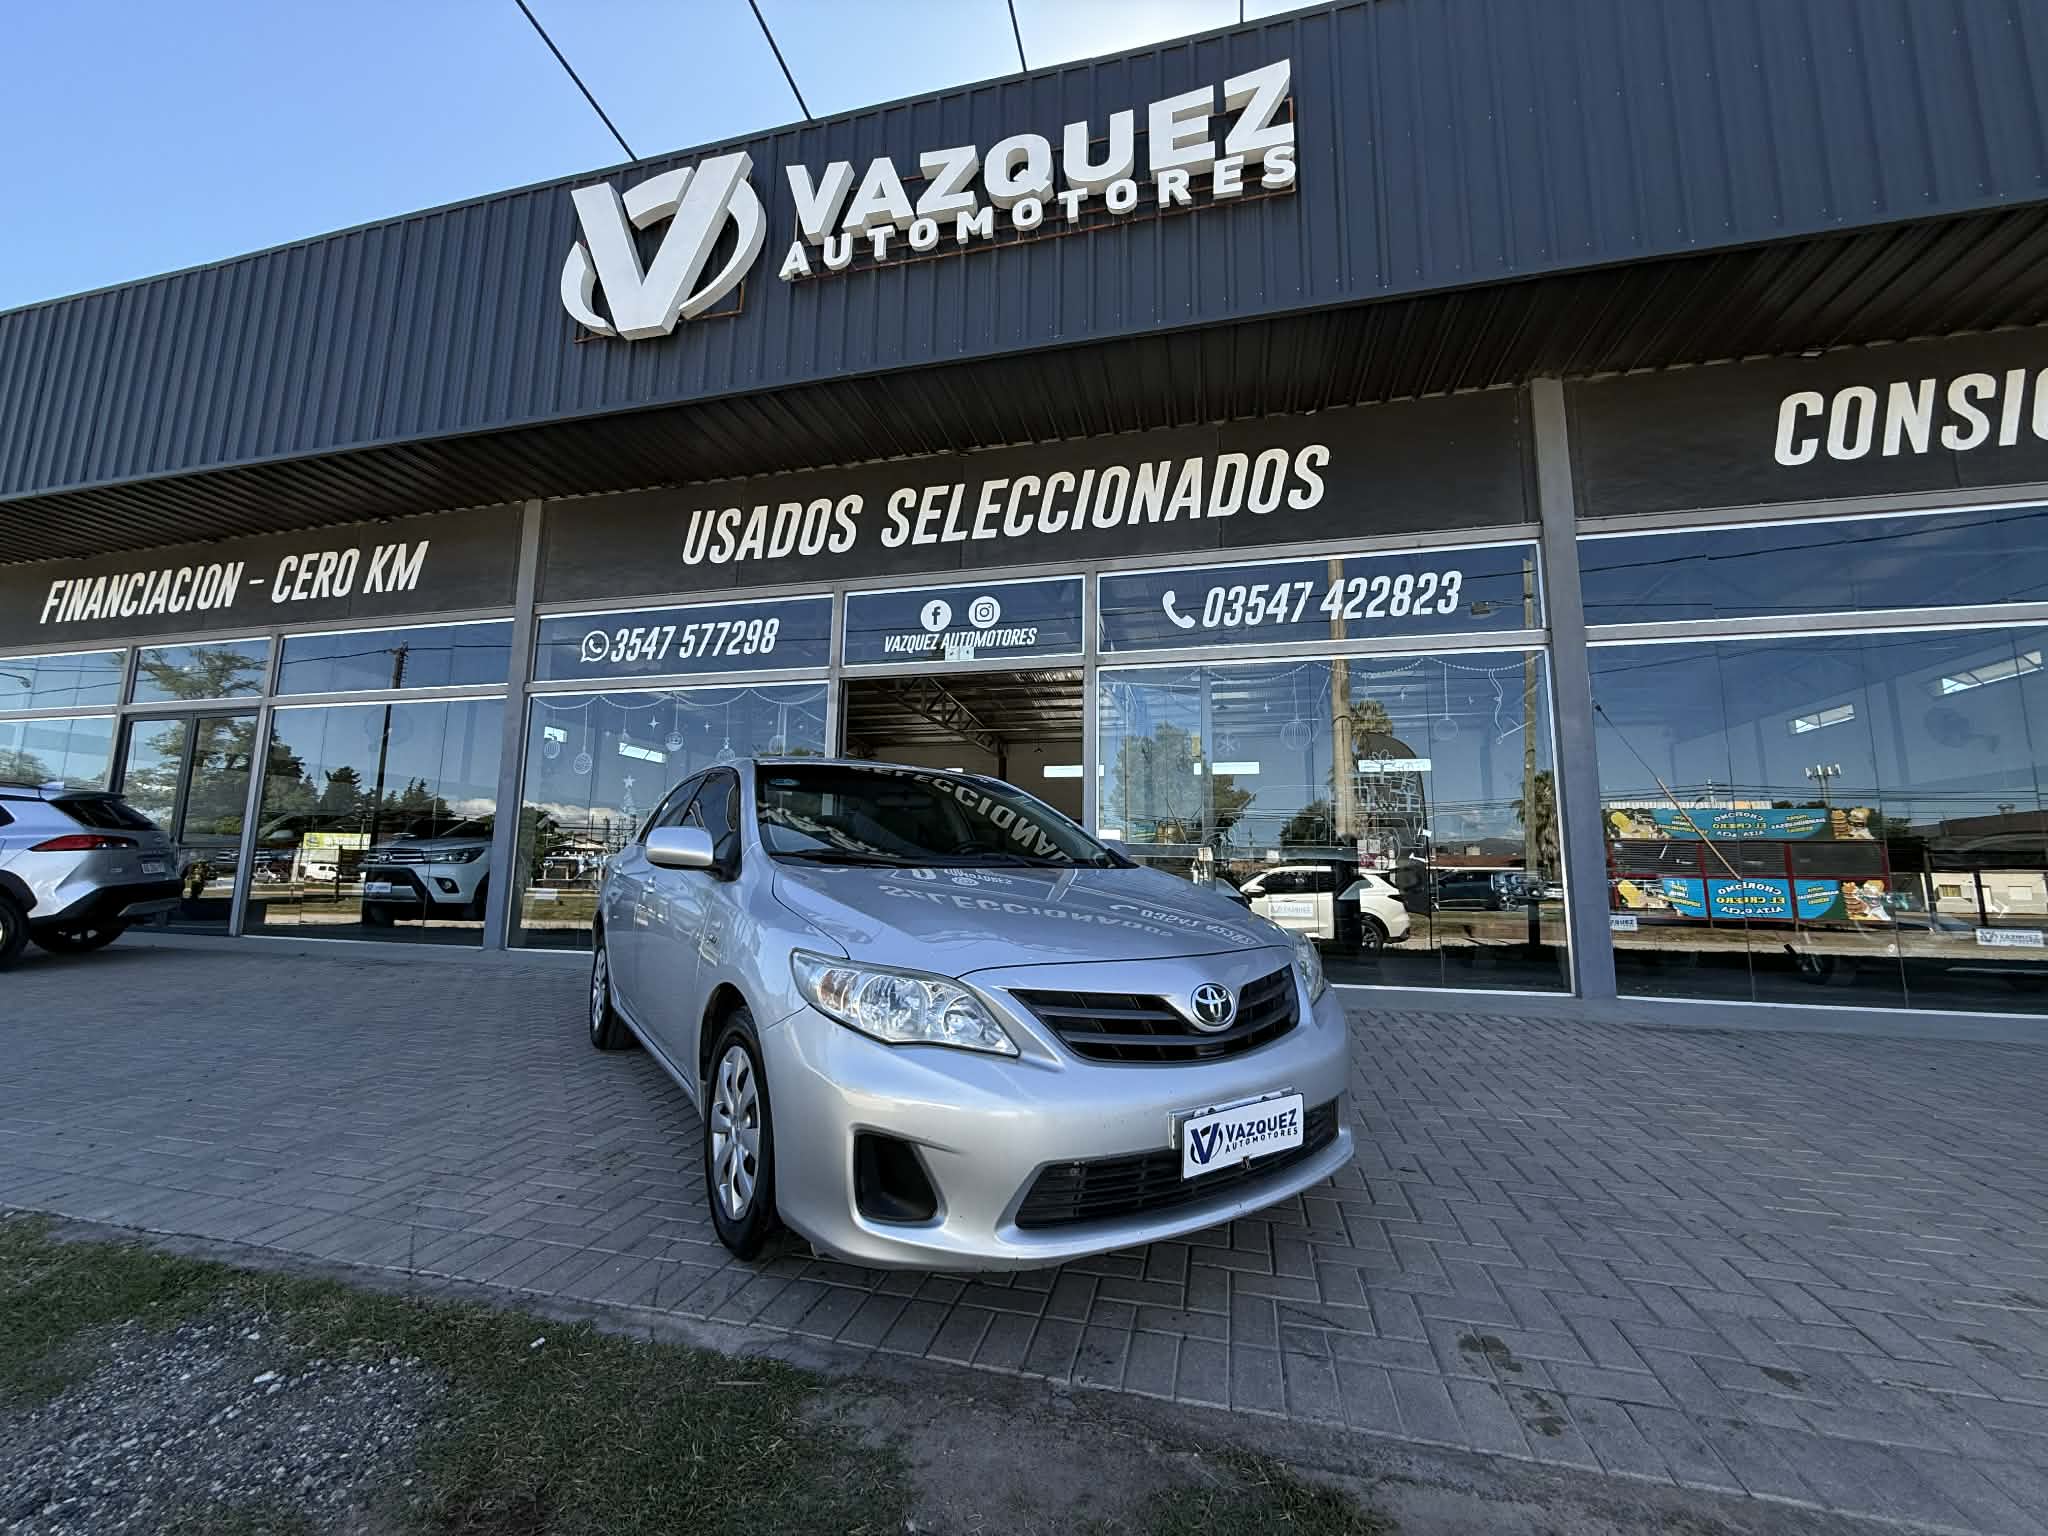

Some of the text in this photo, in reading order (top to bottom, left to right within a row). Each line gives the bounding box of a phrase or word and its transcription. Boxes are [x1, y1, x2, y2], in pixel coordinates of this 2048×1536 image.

[785, 58, 1295, 245] VAZQUEZ
[779, 146, 1296, 281] AUTOMOTORES
[682, 444, 1330, 565] USADOS SELECCIONADOS
[40, 562, 244, 624] FINANCIACION
[271, 547, 361, 604] CERO
[363, 540, 431, 593] KM
[1202, 569, 1463, 628] 03547 422823
[610, 617, 780, 662] 3547 577298
[884, 628, 1037, 653] VAZQUEZ AUTOMOTORES
[1225, 1108, 1297, 1142] VAZQUEZ
[1225, 1127, 1298, 1154] AUTOMOTORES
